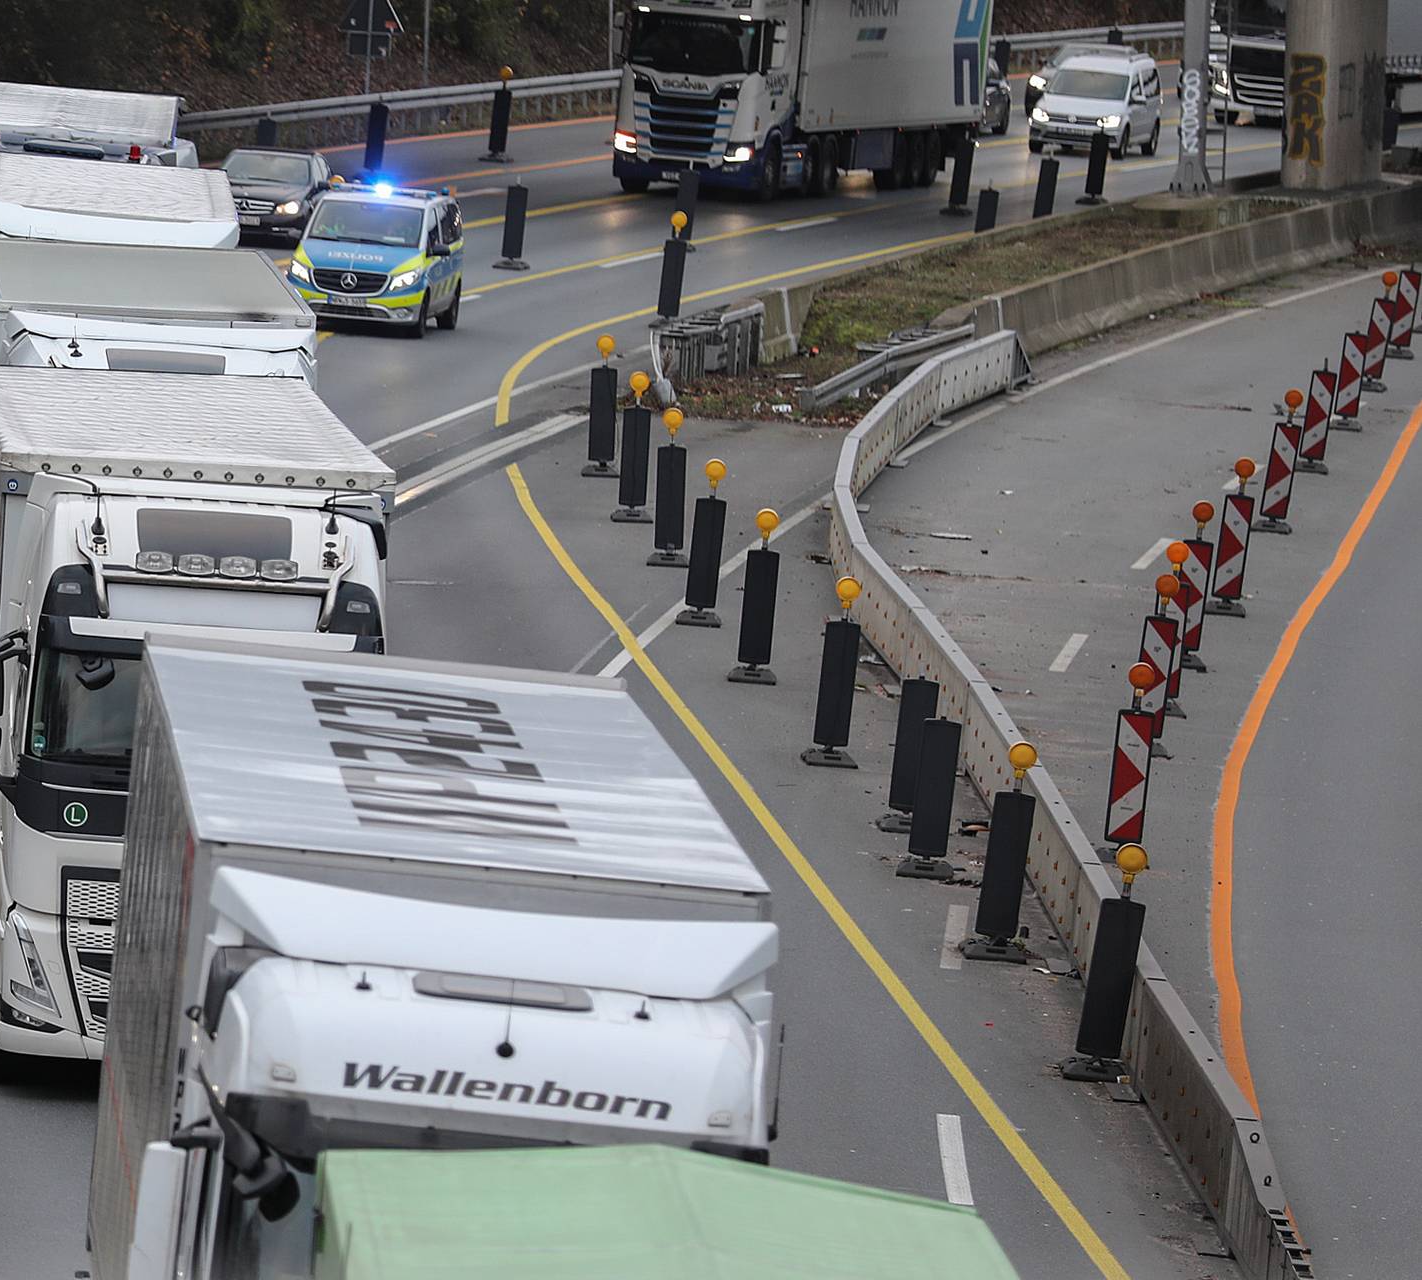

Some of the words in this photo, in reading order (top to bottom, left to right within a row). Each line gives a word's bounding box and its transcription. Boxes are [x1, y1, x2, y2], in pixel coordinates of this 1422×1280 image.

[662, 79, 710, 91] SCANIA
[71, 807, 81, 822] L
[342, 1062, 673, 1121] Wallenborn
